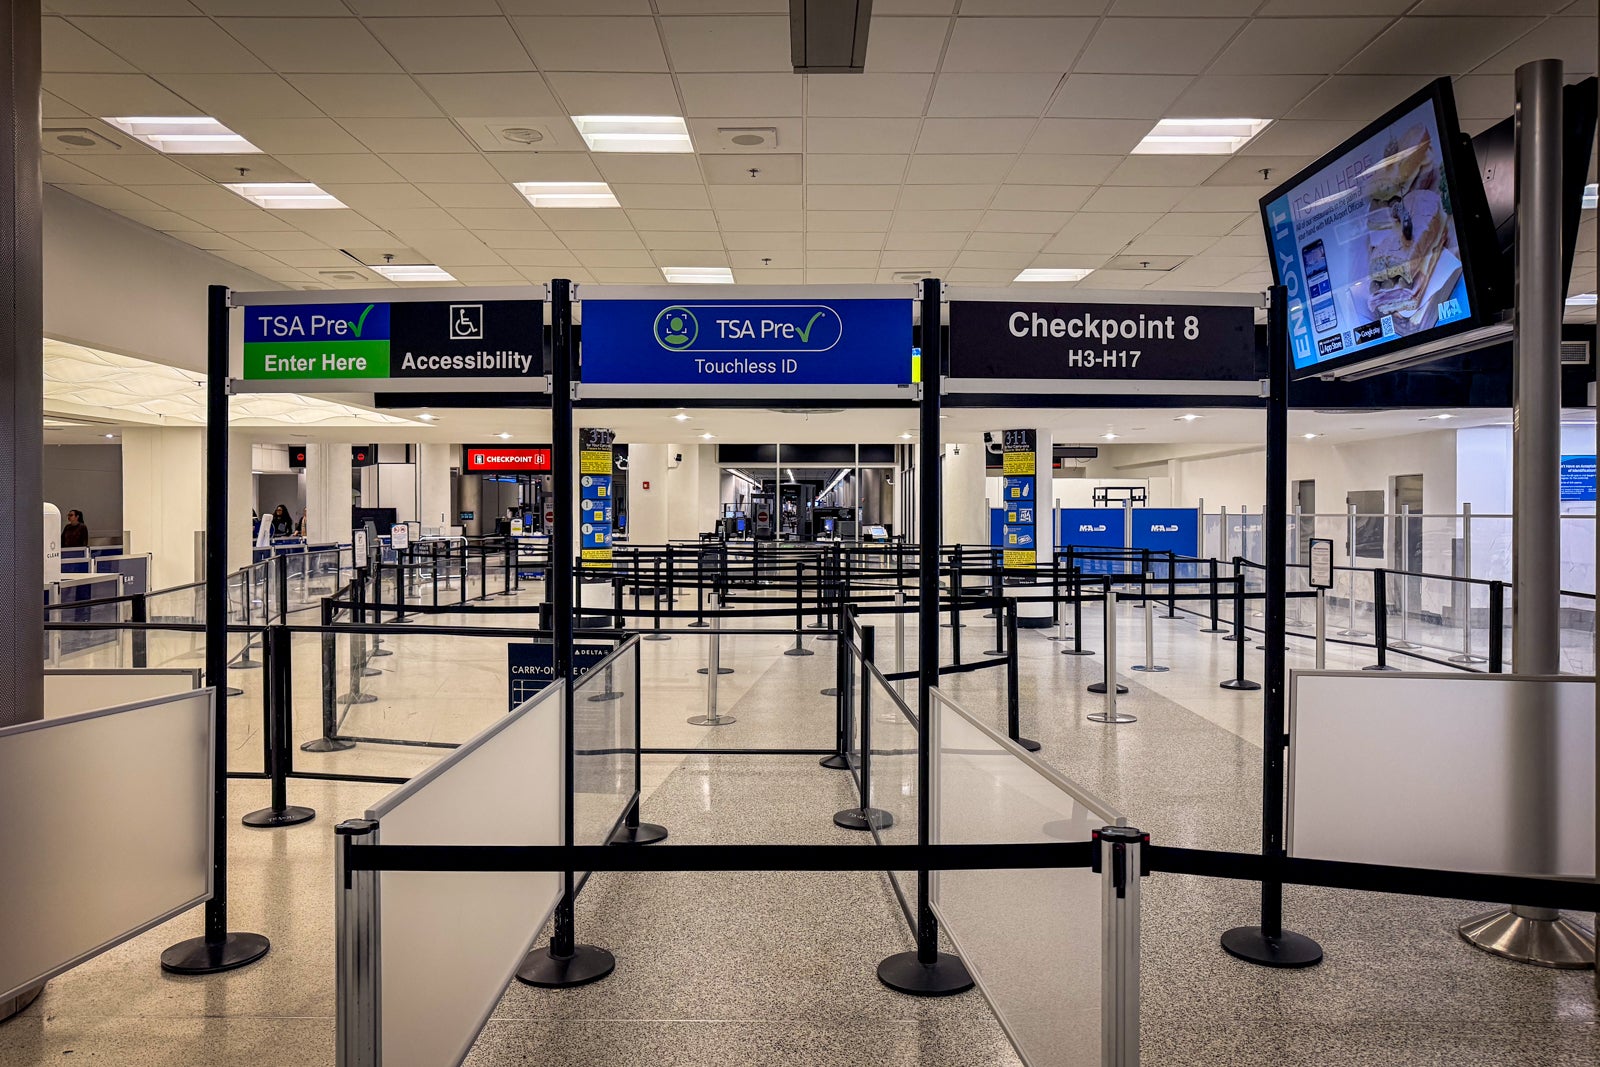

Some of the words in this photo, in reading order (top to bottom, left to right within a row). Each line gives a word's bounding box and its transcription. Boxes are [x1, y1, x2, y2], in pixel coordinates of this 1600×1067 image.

[1271, 210, 1289, 240] IT
[1278, 252, 1312, 359] ENJOY
[258, 315, 304, 337] TSA
[716, 319, 756, 339] TSA
[1008, 311, 1175, 345] Checkpoint
[1183, 315, 1200, 341] 8
[265, 355, 316, 371] Enter
[322, 353, 367, 371] Here
[401, 350, 533, 374] Accessibility
[694, 358, 777, 374] Touchless
[781, 358, 798, 374] ID
[1068, 349, 1142, 368] H3-H17
[1005, 431, 1027, 445] 3-1-1
[486, 455, 533, 463] CHECKPOINT
